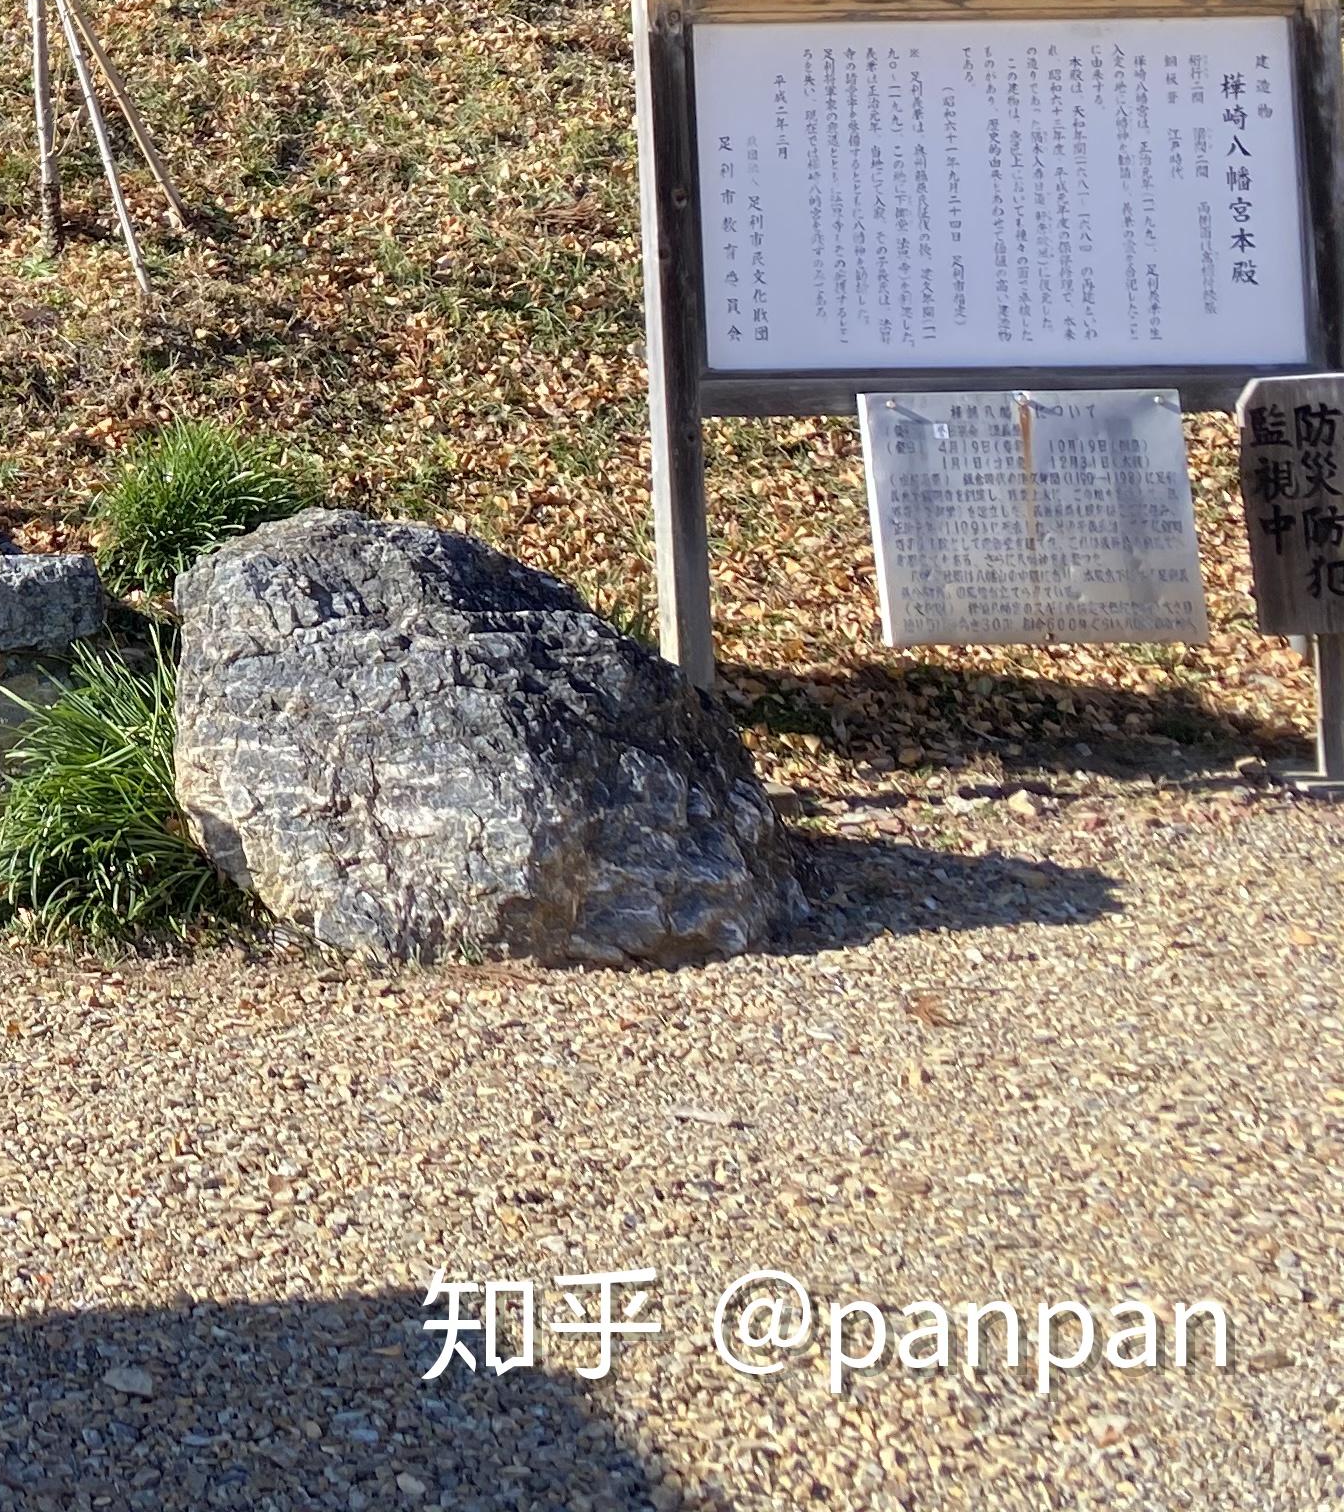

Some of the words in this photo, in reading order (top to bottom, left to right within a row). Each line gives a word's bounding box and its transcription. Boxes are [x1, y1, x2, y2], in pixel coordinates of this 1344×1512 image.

[773, 74, 790, 160] 平成二年三月
[1167, 127, 1185, 180] 江戸時代
[1255, 54, 1273, 119] 建造物
[718, 135, 743, 343] 足利市教育委員会
[1220, 71, 1260, 286] 樺崎八幡宮本殿
[748, 194, 769, 342] 足利市民文化財団
[1249, 404, 1299, 555] 監視中
[1294, 402, 1344, 599] 防災防犯
